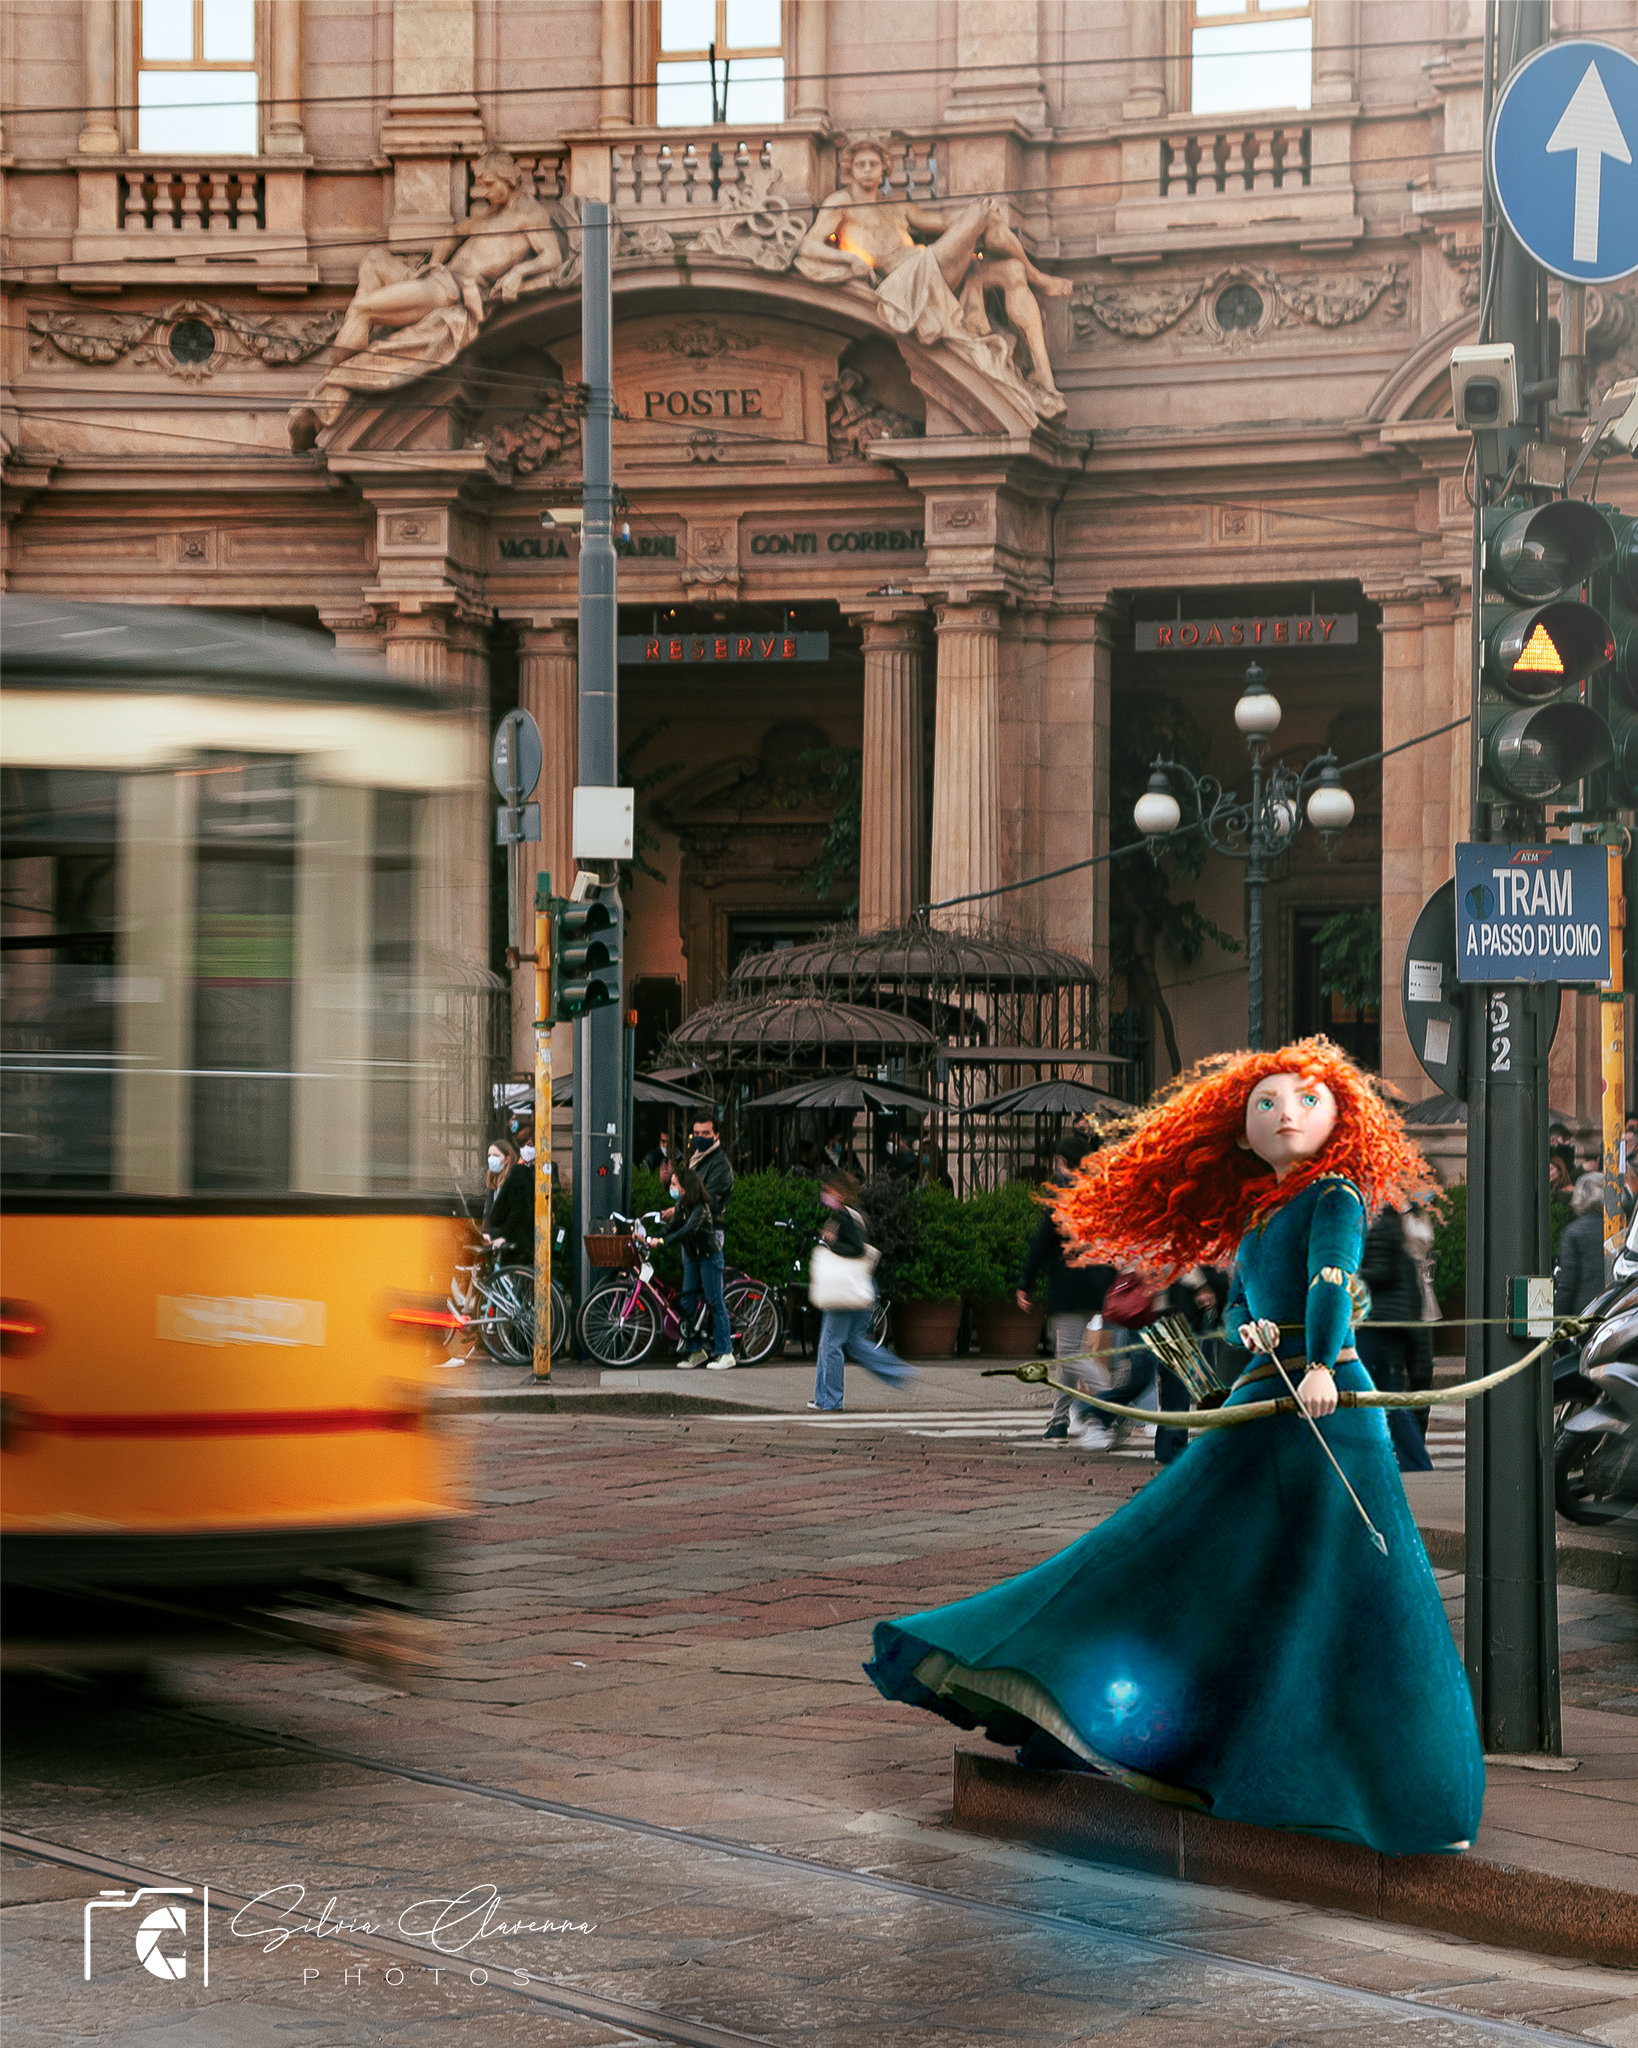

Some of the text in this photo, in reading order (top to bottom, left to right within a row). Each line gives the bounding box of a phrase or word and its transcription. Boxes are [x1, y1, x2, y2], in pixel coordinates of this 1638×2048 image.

[643, 388, 762, 417] POSTE
[751, 529, 926, 555] CONTI CORRENT
[1157, 618, 1336, 647] ROASTERY
[645, 636, 797, 660] RESERVE
[1520, 852, 1539, 862] ATM
[1492, 868, 1573, 917] TRAM
[1466, 923, 1602, 957] A PASSO D'UOMO
